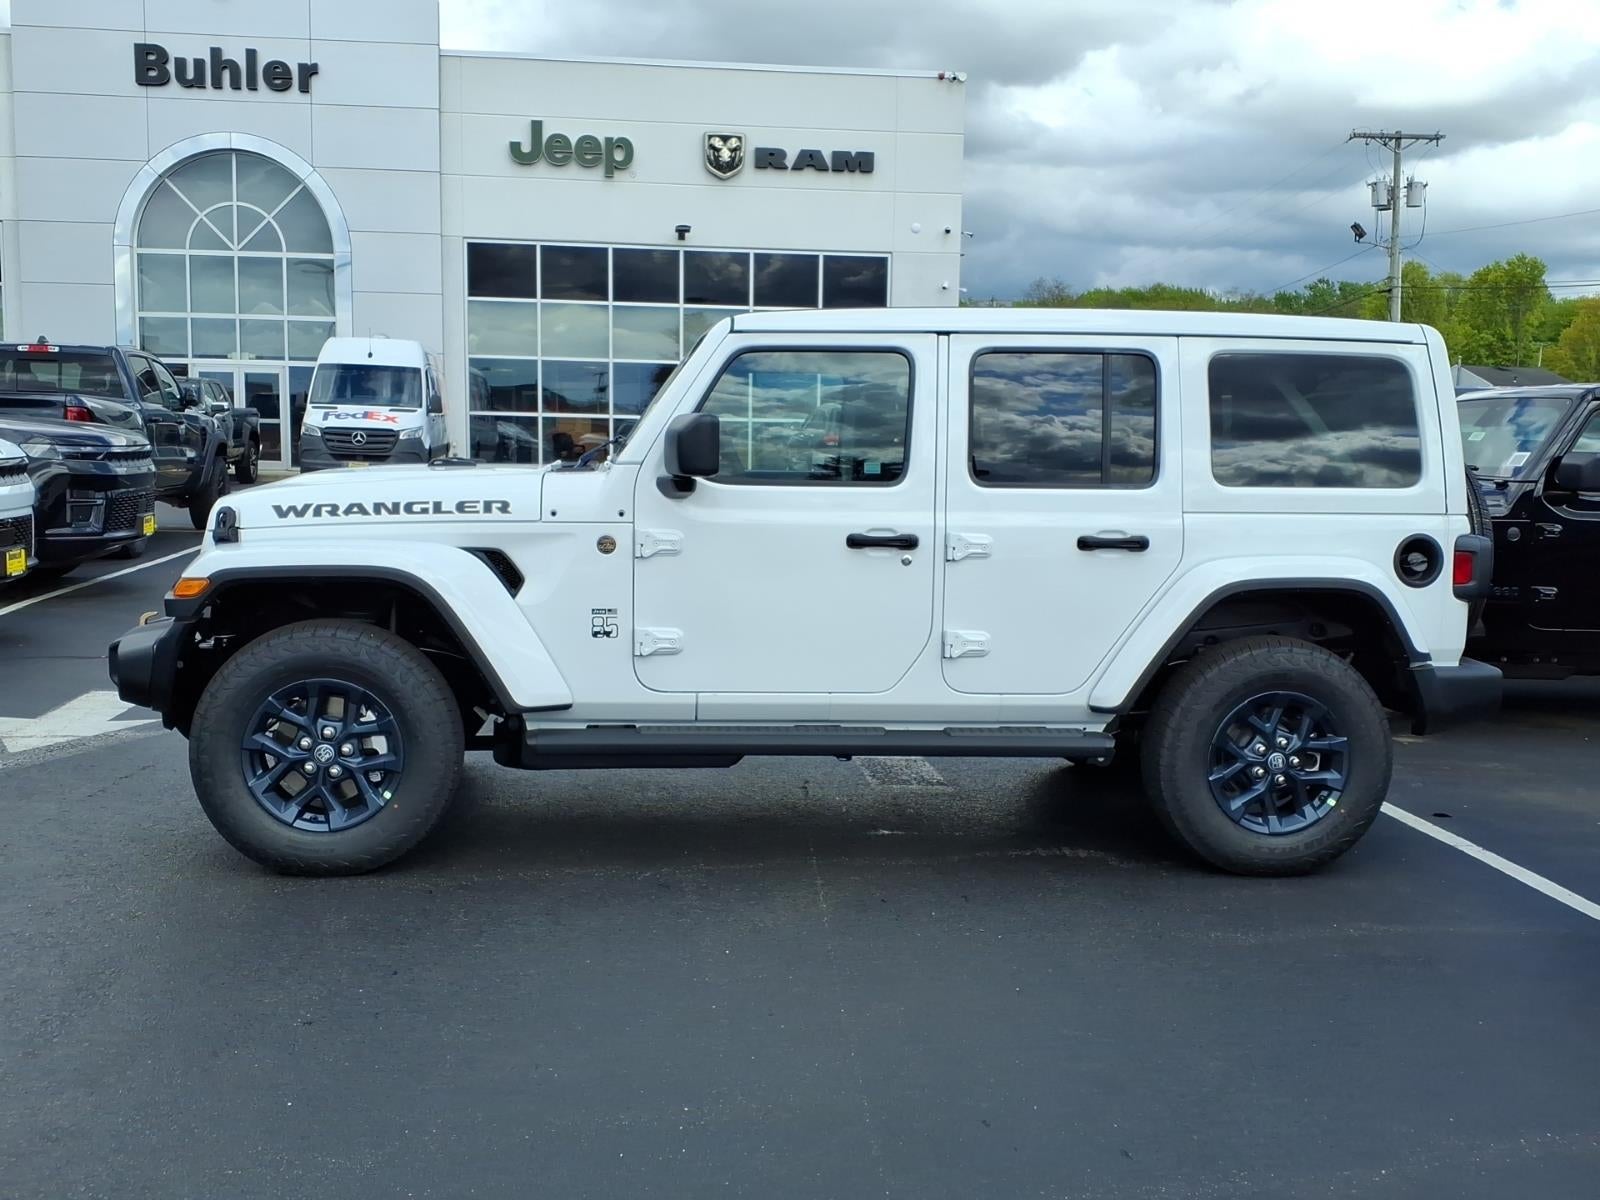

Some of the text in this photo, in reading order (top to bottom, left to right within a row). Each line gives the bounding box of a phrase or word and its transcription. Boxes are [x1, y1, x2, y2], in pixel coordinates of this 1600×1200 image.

[134, 43, 319, 93] Buhler
[509, 119, 634, 178] Jeep
[754, 146, 875, 173] RAM
[322, 410, 399, 424] FedEx
[272, 500, 512, 519] WRANGLER
